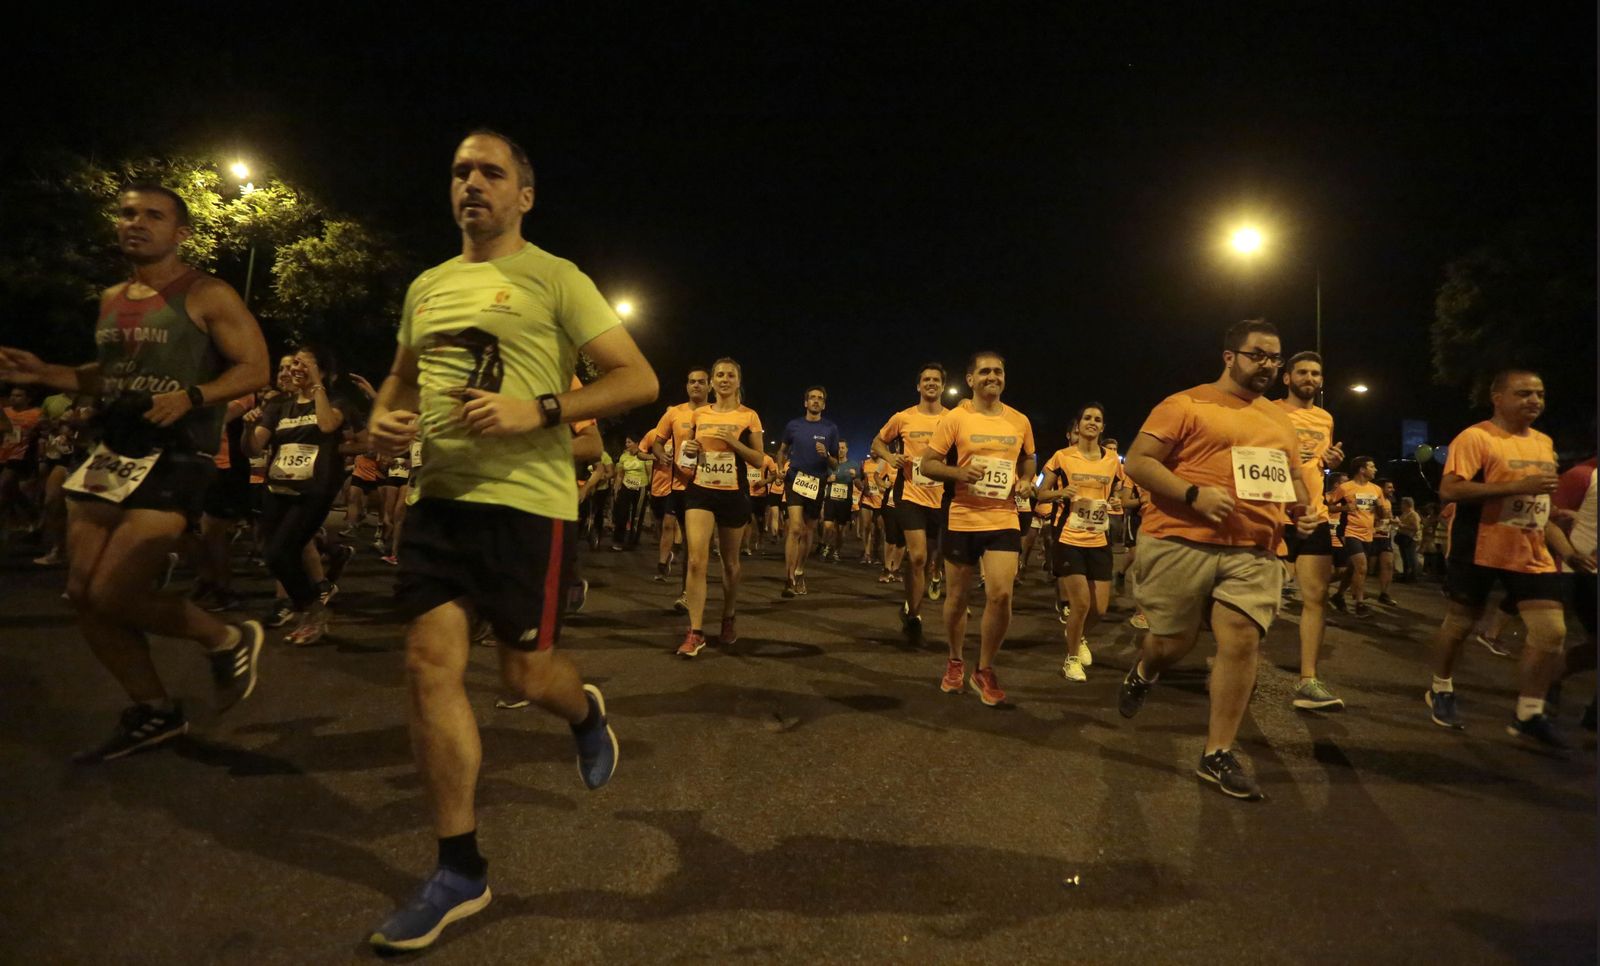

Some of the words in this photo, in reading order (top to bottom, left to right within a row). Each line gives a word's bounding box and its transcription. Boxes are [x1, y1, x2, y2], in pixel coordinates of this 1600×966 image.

[133, 327, 169, 344] DANI
[701, 463, 733, 474] 16442
[1238, 464, 1288, 483] 16408
[795, 479, 819, 492] 20440
[1512, 499, 1547, 515] 9764
[1077, 508, 1105, 521] 5152
